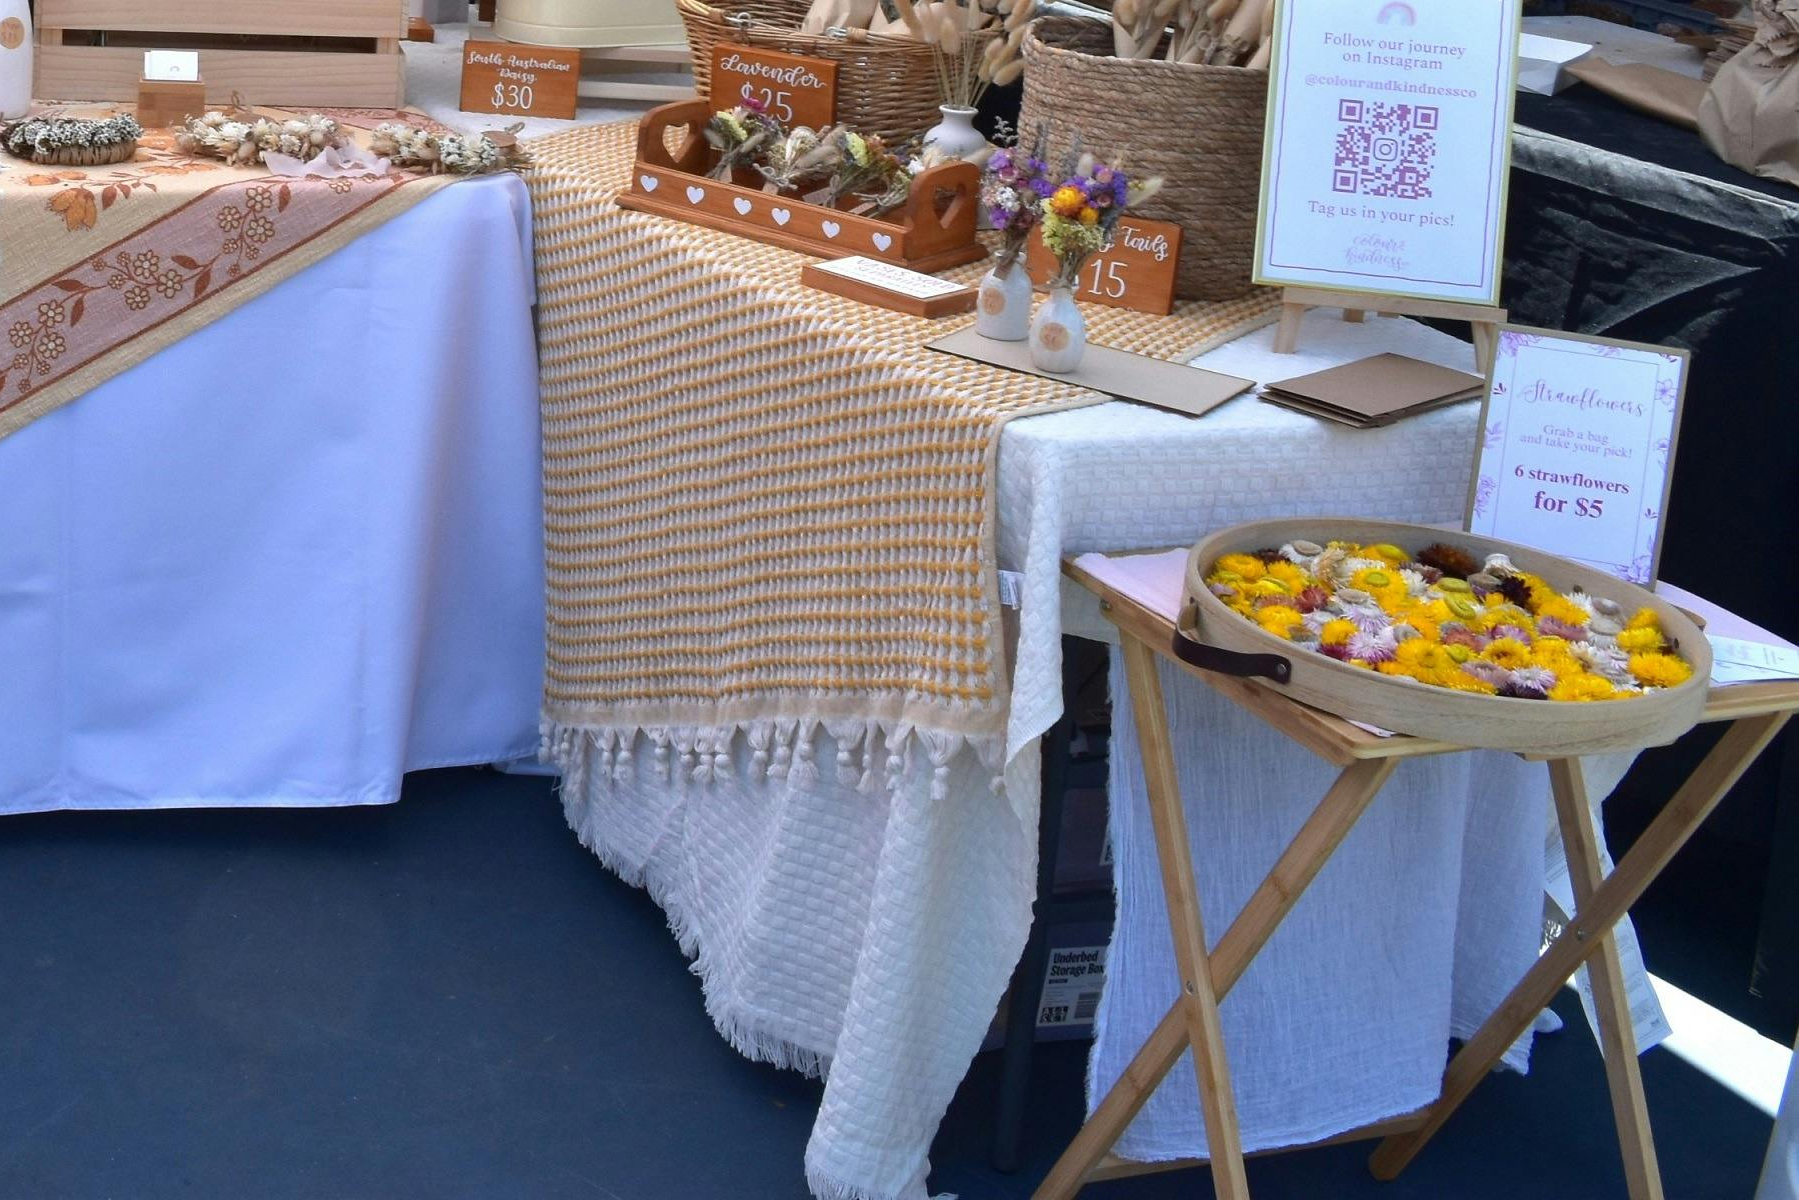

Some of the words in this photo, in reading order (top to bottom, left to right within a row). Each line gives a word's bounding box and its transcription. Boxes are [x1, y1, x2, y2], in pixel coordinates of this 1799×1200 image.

[1323, 32, 1374, 49] Follow
[1378, 39, 1404, 51] our
[1409, 39, 1467, 60] journey
[466, 51, 503, 65] South
[507, 55, 570, 72] Australian
[720, 53, 827, 89] Lavender
[1342, 52, 1361, 64] on
[1366, 51, 1443, 71] Instagram
[491, 81, 533, 110] $30
[1305, 73, 1478, 99] @colourandkindnessco
[1308, 200, 1335, 218] Tag
[1340, 206, 1358, 217] us
[1362, 205, 1377, 218] in
[1380, 209, 1416, 226] your
[1419, 211, 1455, 228] pics!
[1072, 259, 1129, 298] 15
[1515, 378, 1645, 417] Strawflowers
[1520, 433, 1541, 445] and
[1545, 437, 1570, 450] take
[1574, 442, 1602, 455] your
[1604, 446, 1632, 459] pick!
[1543, 424, 1575, 439] Grab
[1587, 431, 1609, 445] bag
[1514, 464, 1524, 478] 6
[1528, 467, 1630, 495] strawflowers
[1533, 490, 1568, 513] for
[1575, 497, 1604, 519] $5
[1053, 950, 1099, 964] Underbed
[1050, 965, 1087, 978] Storage
